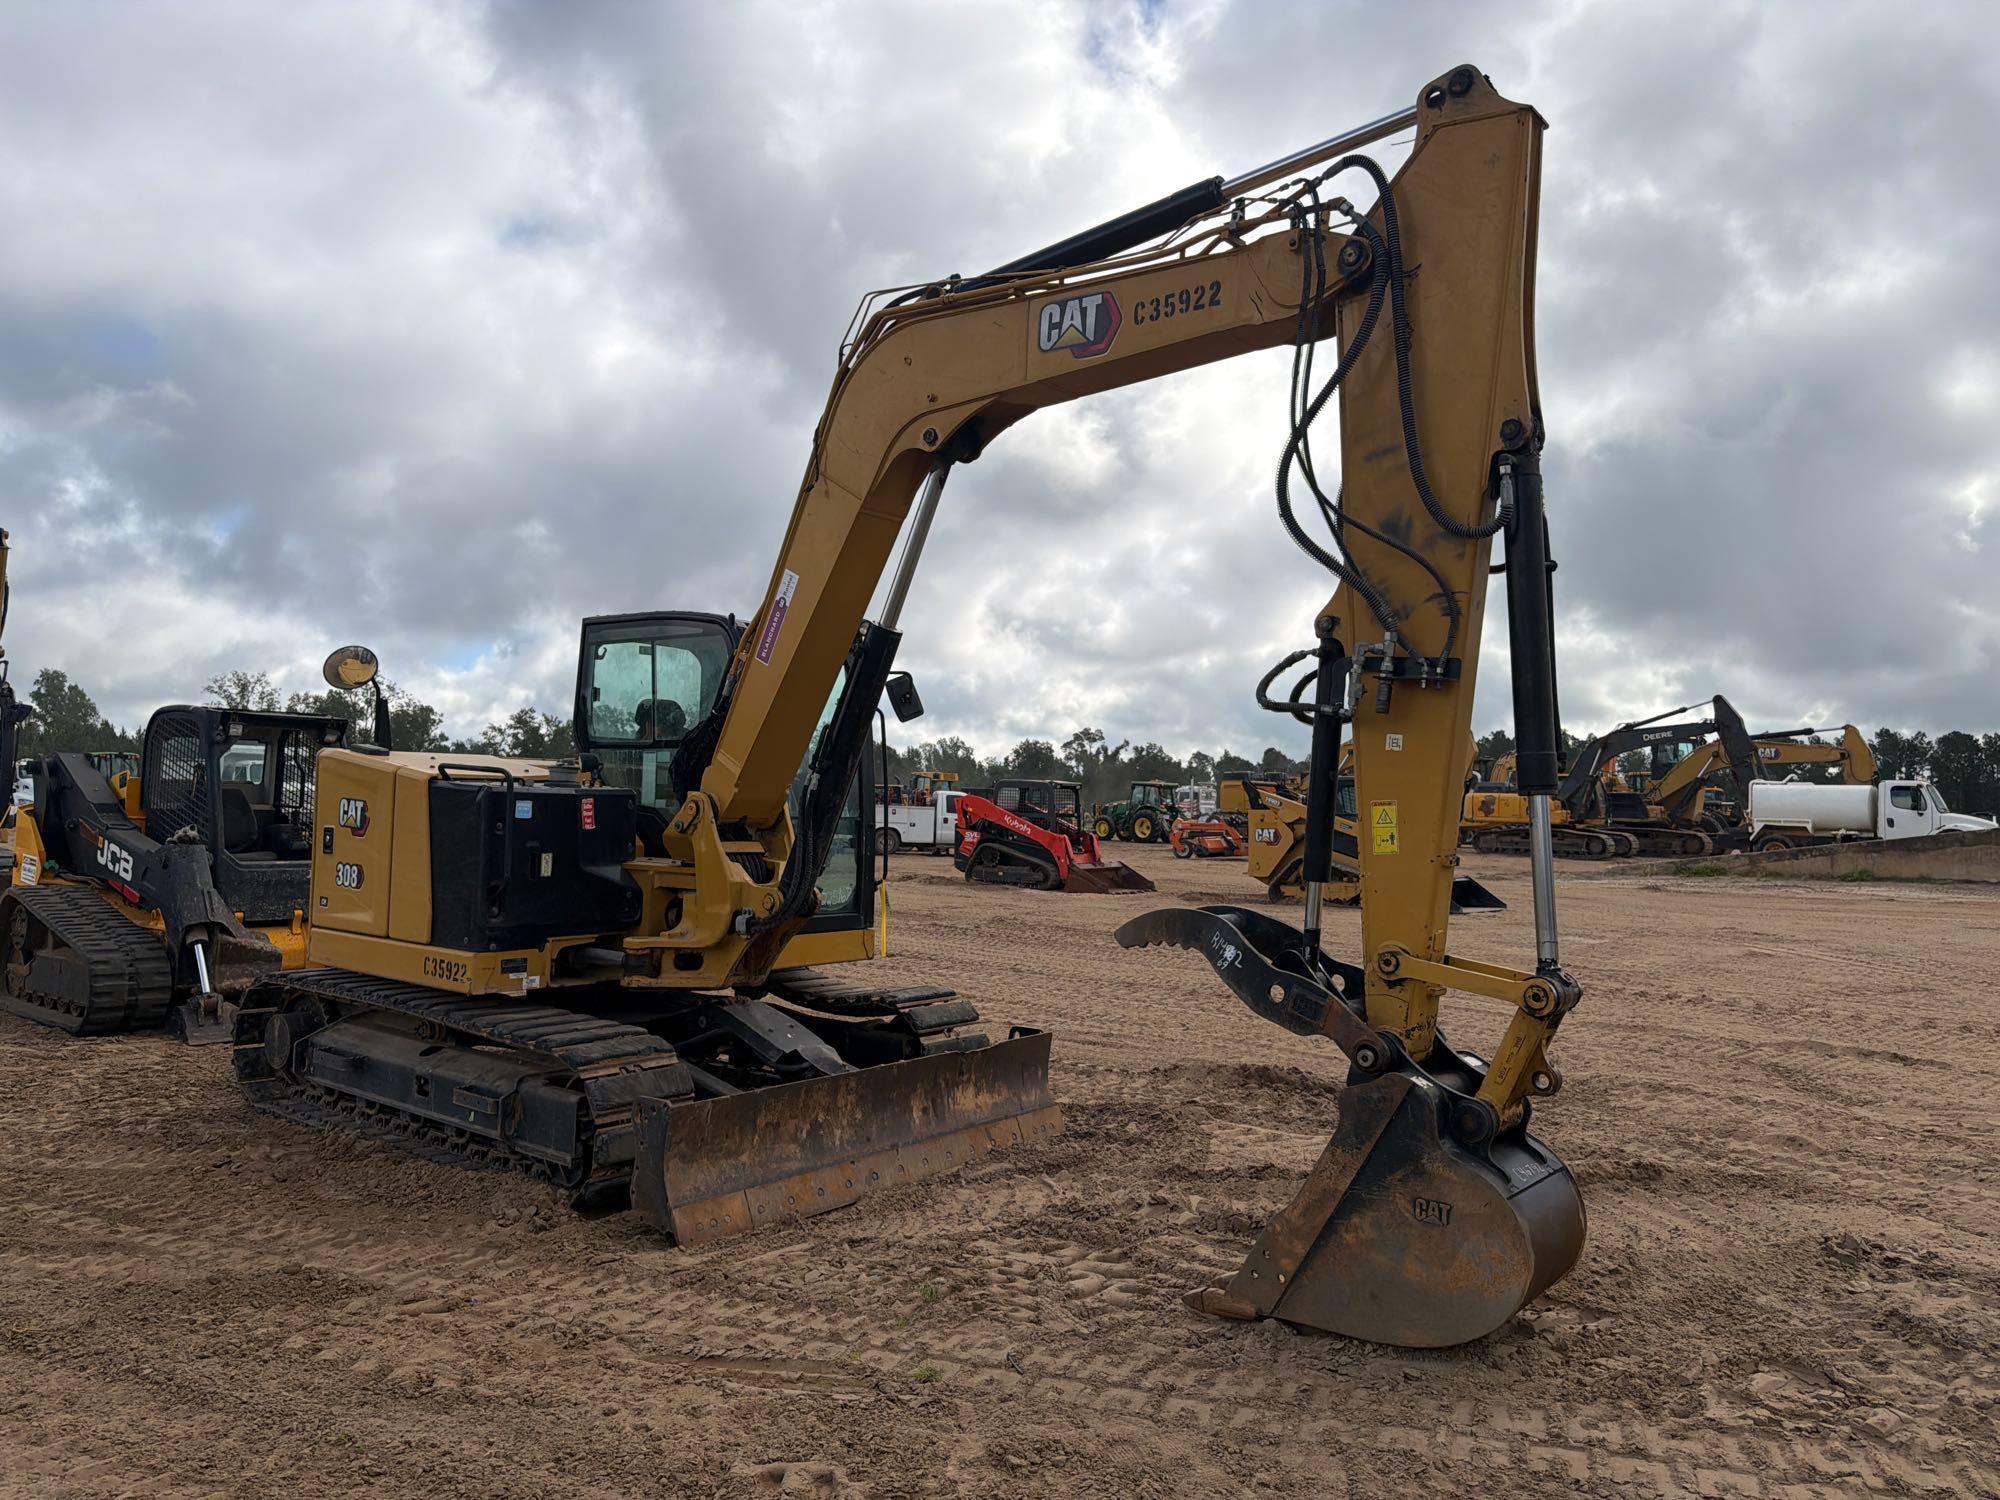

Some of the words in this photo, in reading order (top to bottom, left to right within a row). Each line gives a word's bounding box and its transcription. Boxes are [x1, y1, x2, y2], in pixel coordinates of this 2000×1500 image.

[1040, 294, 1103, 351] CAT
[1133, 280, 1222, 325] C35922
[761, 611, 781, 657] BLANCHARD
[1643, 731, 1673, 741] DEERE
[1758, 748, 1776, 758] CAT
[340, 799, 364, 827] CAT
[1004, 815, 1031, 835] Kubota
[1255, 829, 1275, 842] CAT
[97, 839, 134, 881] JCB
[336, 863, 358, 888] 308
[423, 956, 468, 983] C35922
[1414, 1198, 1451, 1228] CAT
